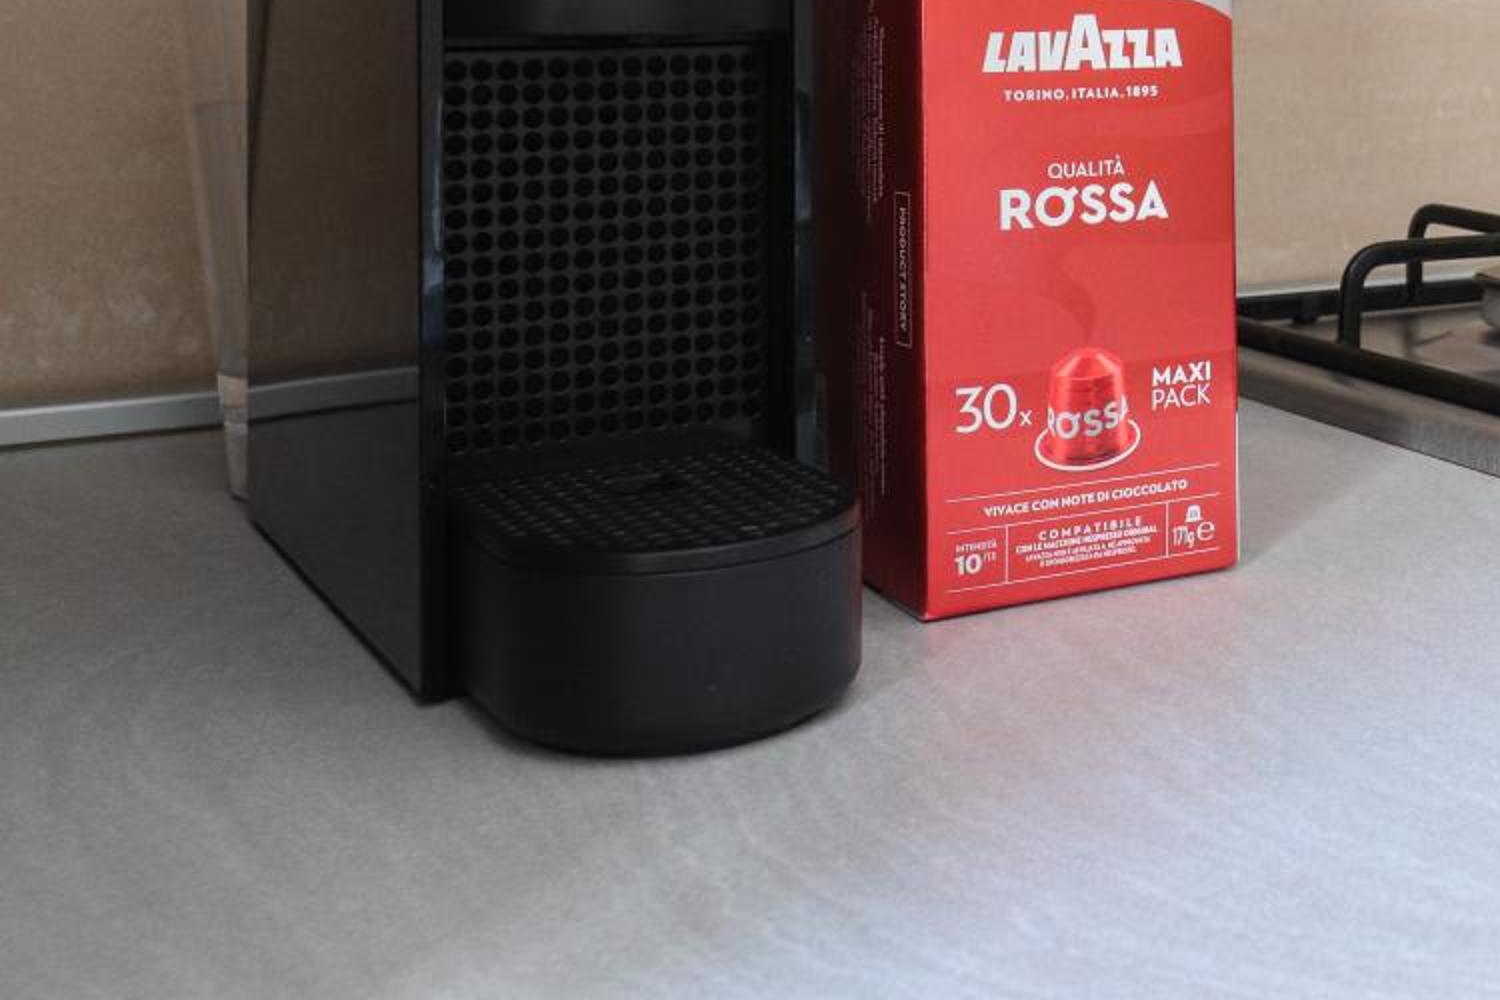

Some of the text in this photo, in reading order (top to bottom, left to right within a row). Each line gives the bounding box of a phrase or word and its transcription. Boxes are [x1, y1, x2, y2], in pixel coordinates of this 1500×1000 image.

[981, 13, 1183, 74] LAVAZZA
[1126, 84, 1159, 98] 1895
[1047, 153, 1125, 179] QUALITÀ
[1000, 179, 1169, 231] ROSSA
[1151, 360, 1212, 387] MAXI
[1151, 384, 1211, 411] PACK
[984, 479, 1188, 517] VIVACE CON NOTE DI CIOCCOLATO
[1039, 515, 1142, 541] COMPATIBILE
